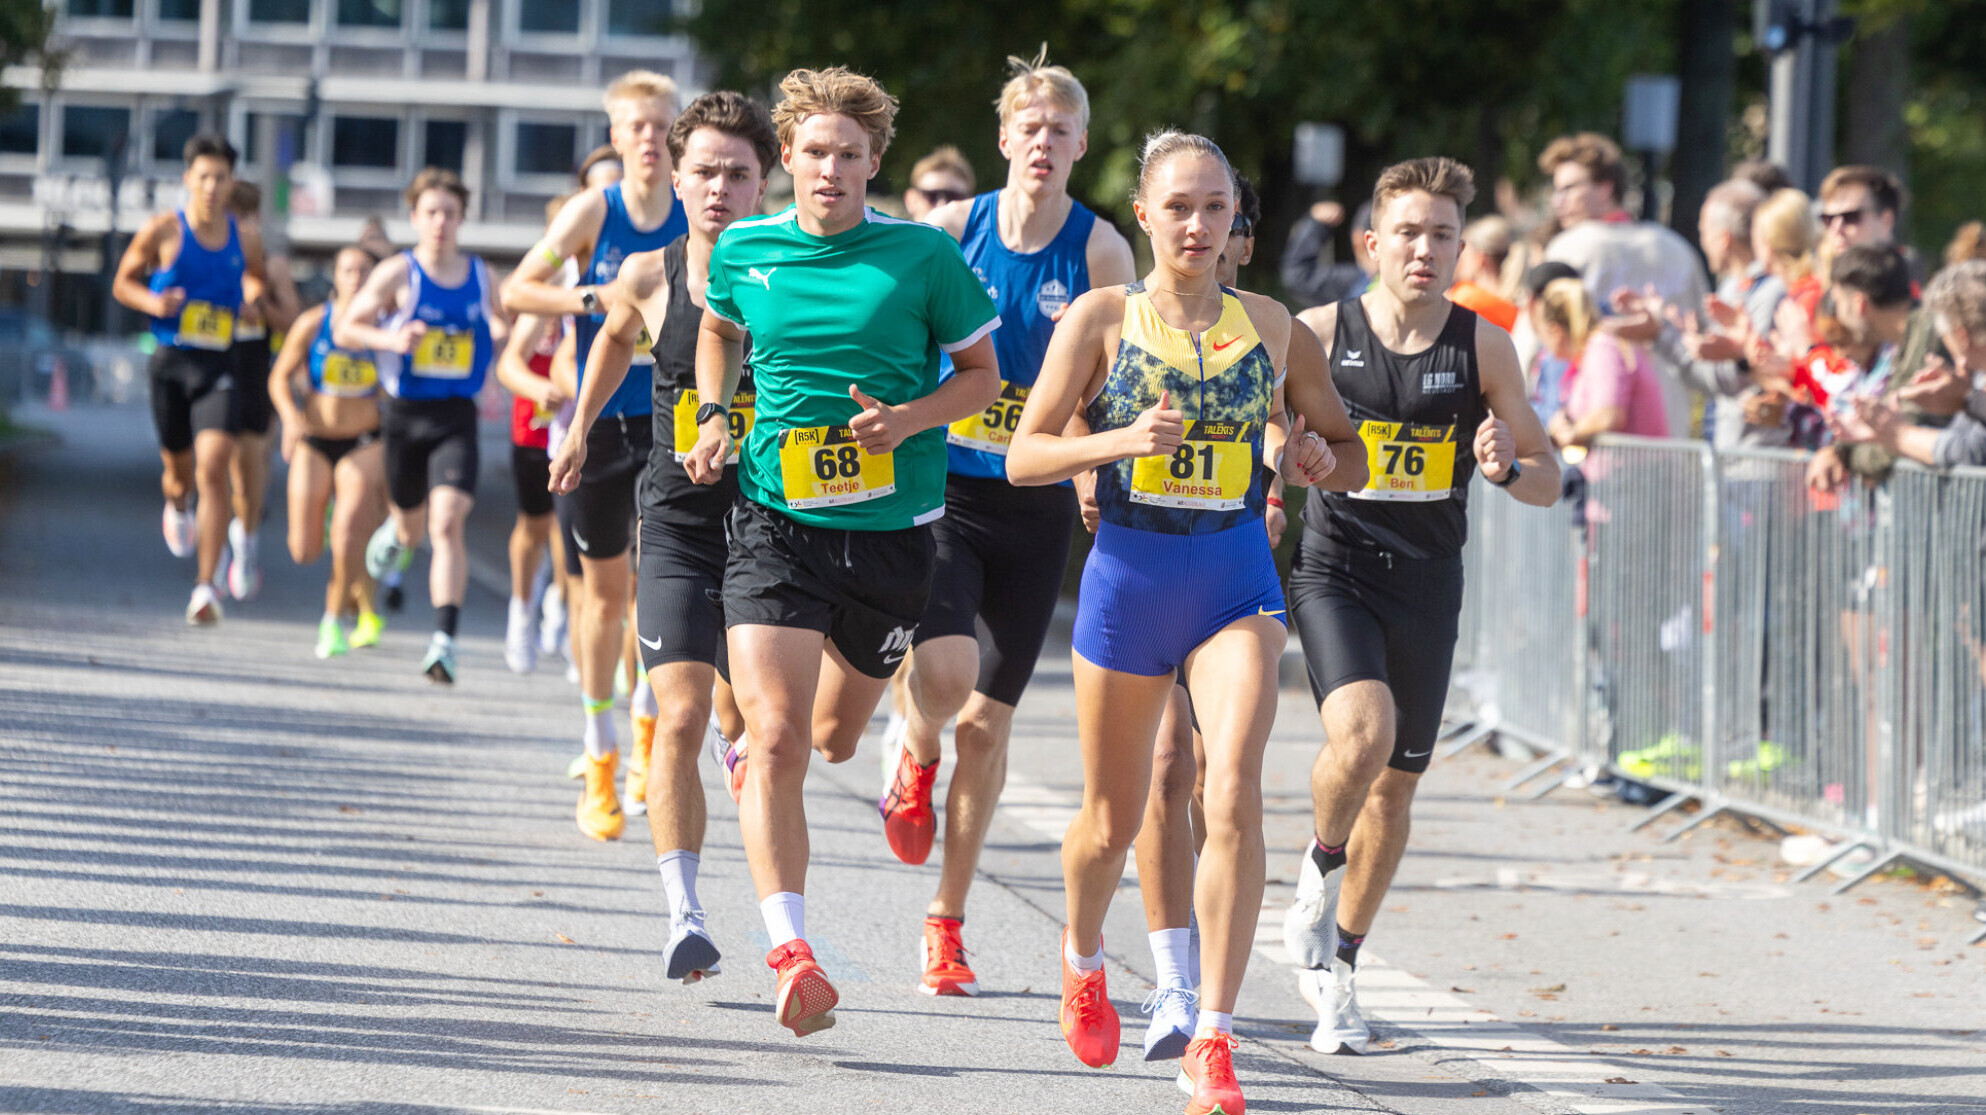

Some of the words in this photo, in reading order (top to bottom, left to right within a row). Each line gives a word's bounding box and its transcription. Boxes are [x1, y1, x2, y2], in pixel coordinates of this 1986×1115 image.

[732, 393, 756, 404] ALENT
[983, 401, 1024, 433] 56
[794, 428, 820, 445] [R5K]
[1204, 425, 1235, 436] TALENTS
[1411, 428, 1441, 438] TALENTS
[814, 446, 861, 480] 68
[1170, 443, 1214, 480] 81
[1383, 444, 1425, 476] 76
[821, 480, 860, 494] Teetje
[1163, 481, 1222, 496] Vanessa
[1390, 478, 1414, 489] Ben
